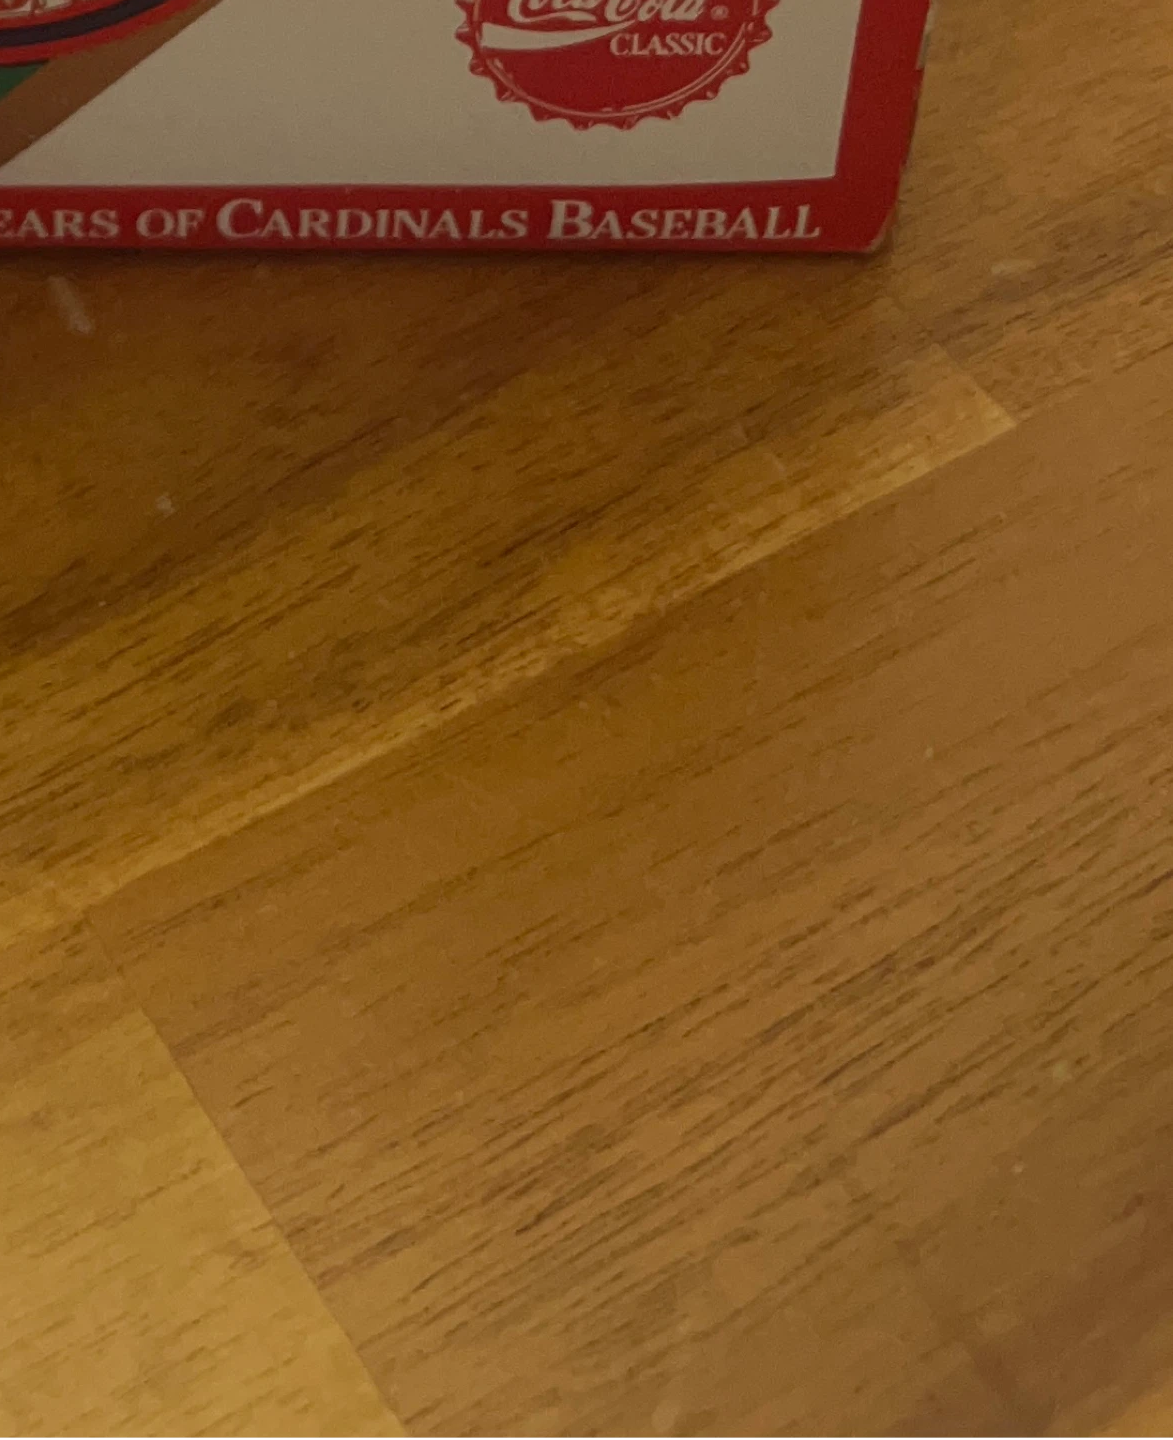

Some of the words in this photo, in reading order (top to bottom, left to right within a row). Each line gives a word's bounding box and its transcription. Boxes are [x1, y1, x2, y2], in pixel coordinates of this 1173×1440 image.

[608, 31, 726, 57] CLASSIC
[215, 197, 528, 241] CARDINALS
[546, 197, 823, 242] BASEBALL
